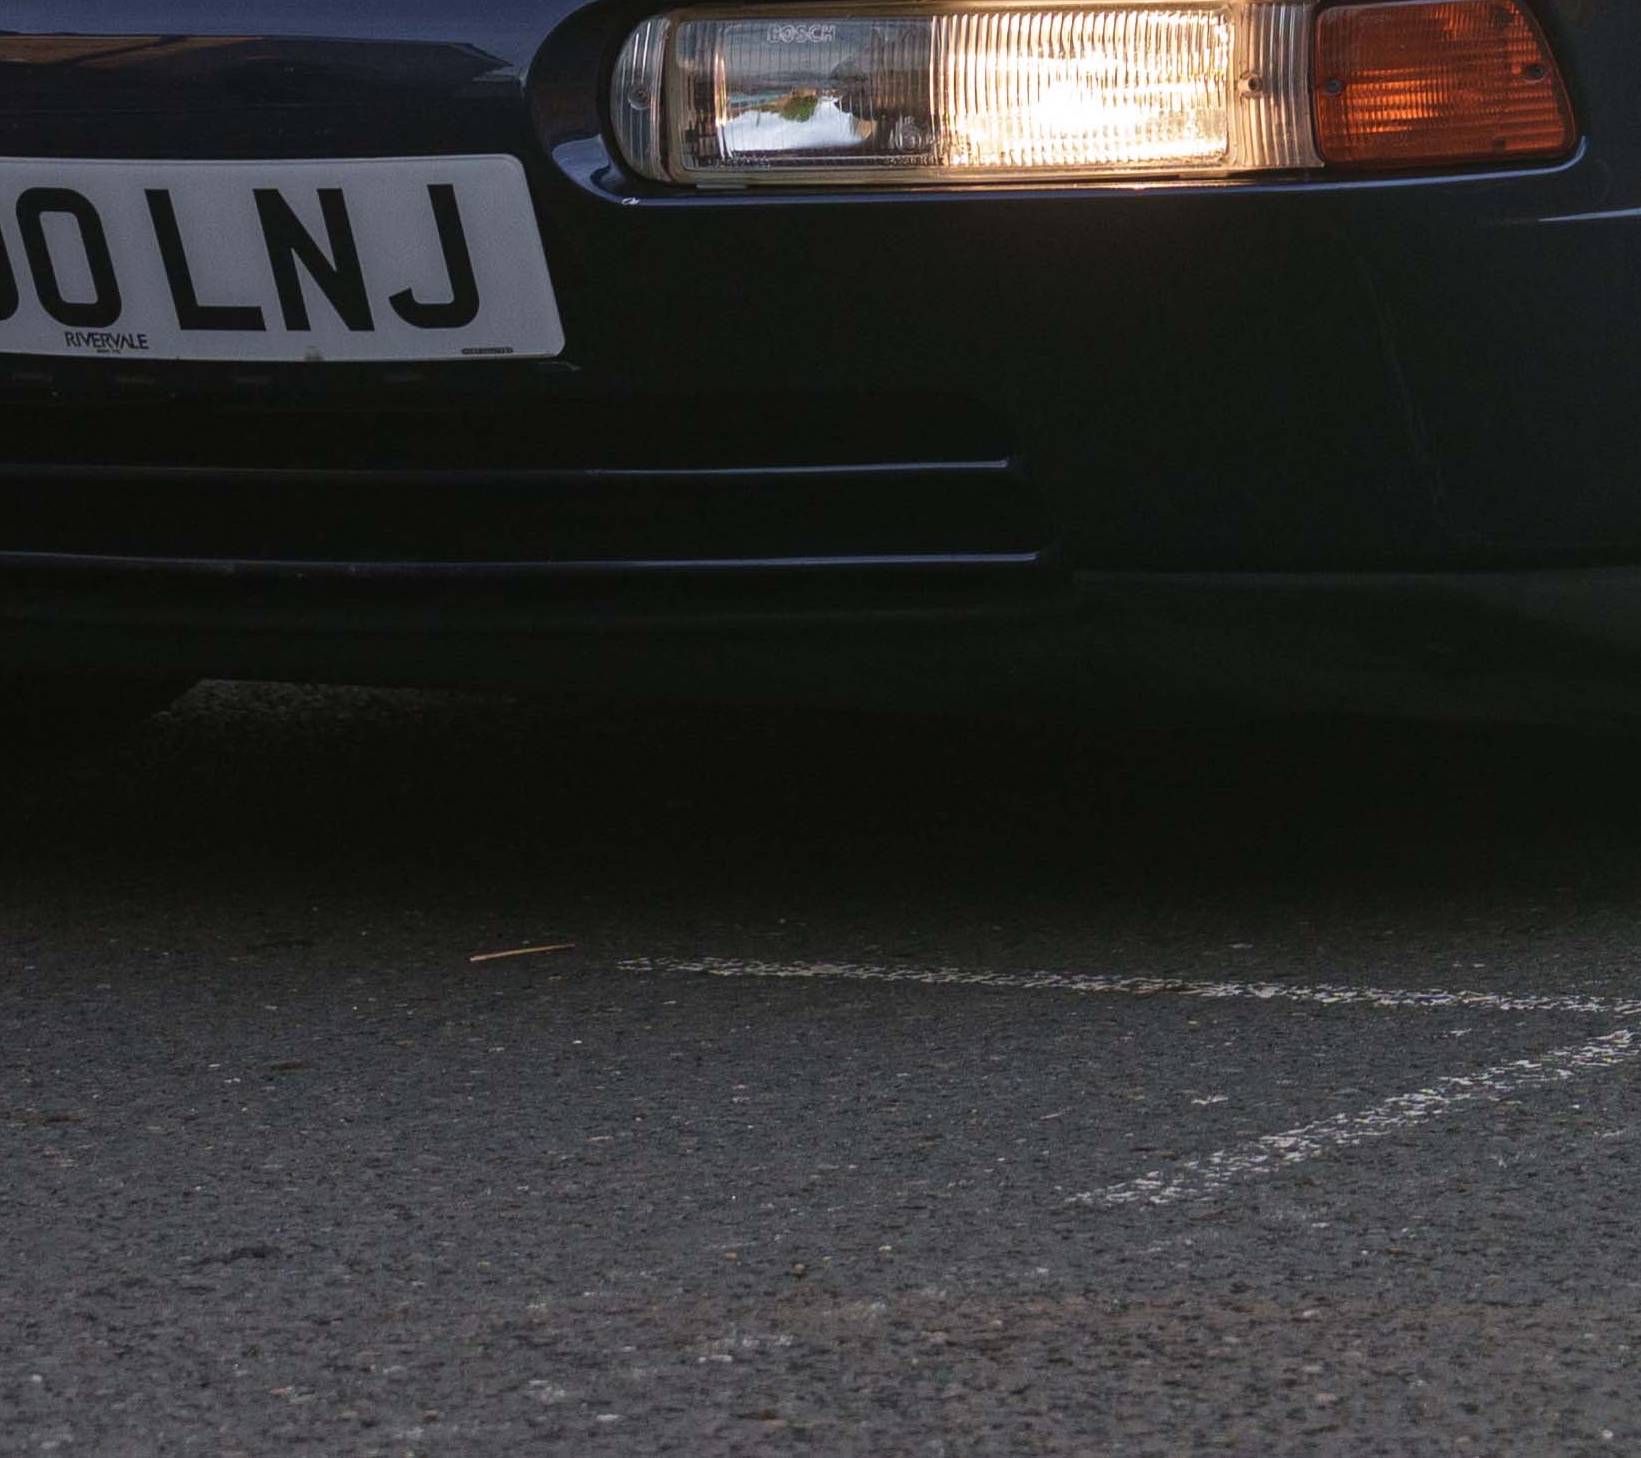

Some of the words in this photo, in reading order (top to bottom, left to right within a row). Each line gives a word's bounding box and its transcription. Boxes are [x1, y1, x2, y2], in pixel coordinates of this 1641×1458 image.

[766, 24, 837, 44] BOSCH
[144, 183, 480, 333] LNJ
[64, 331, 149, 350] RIVERVALE
